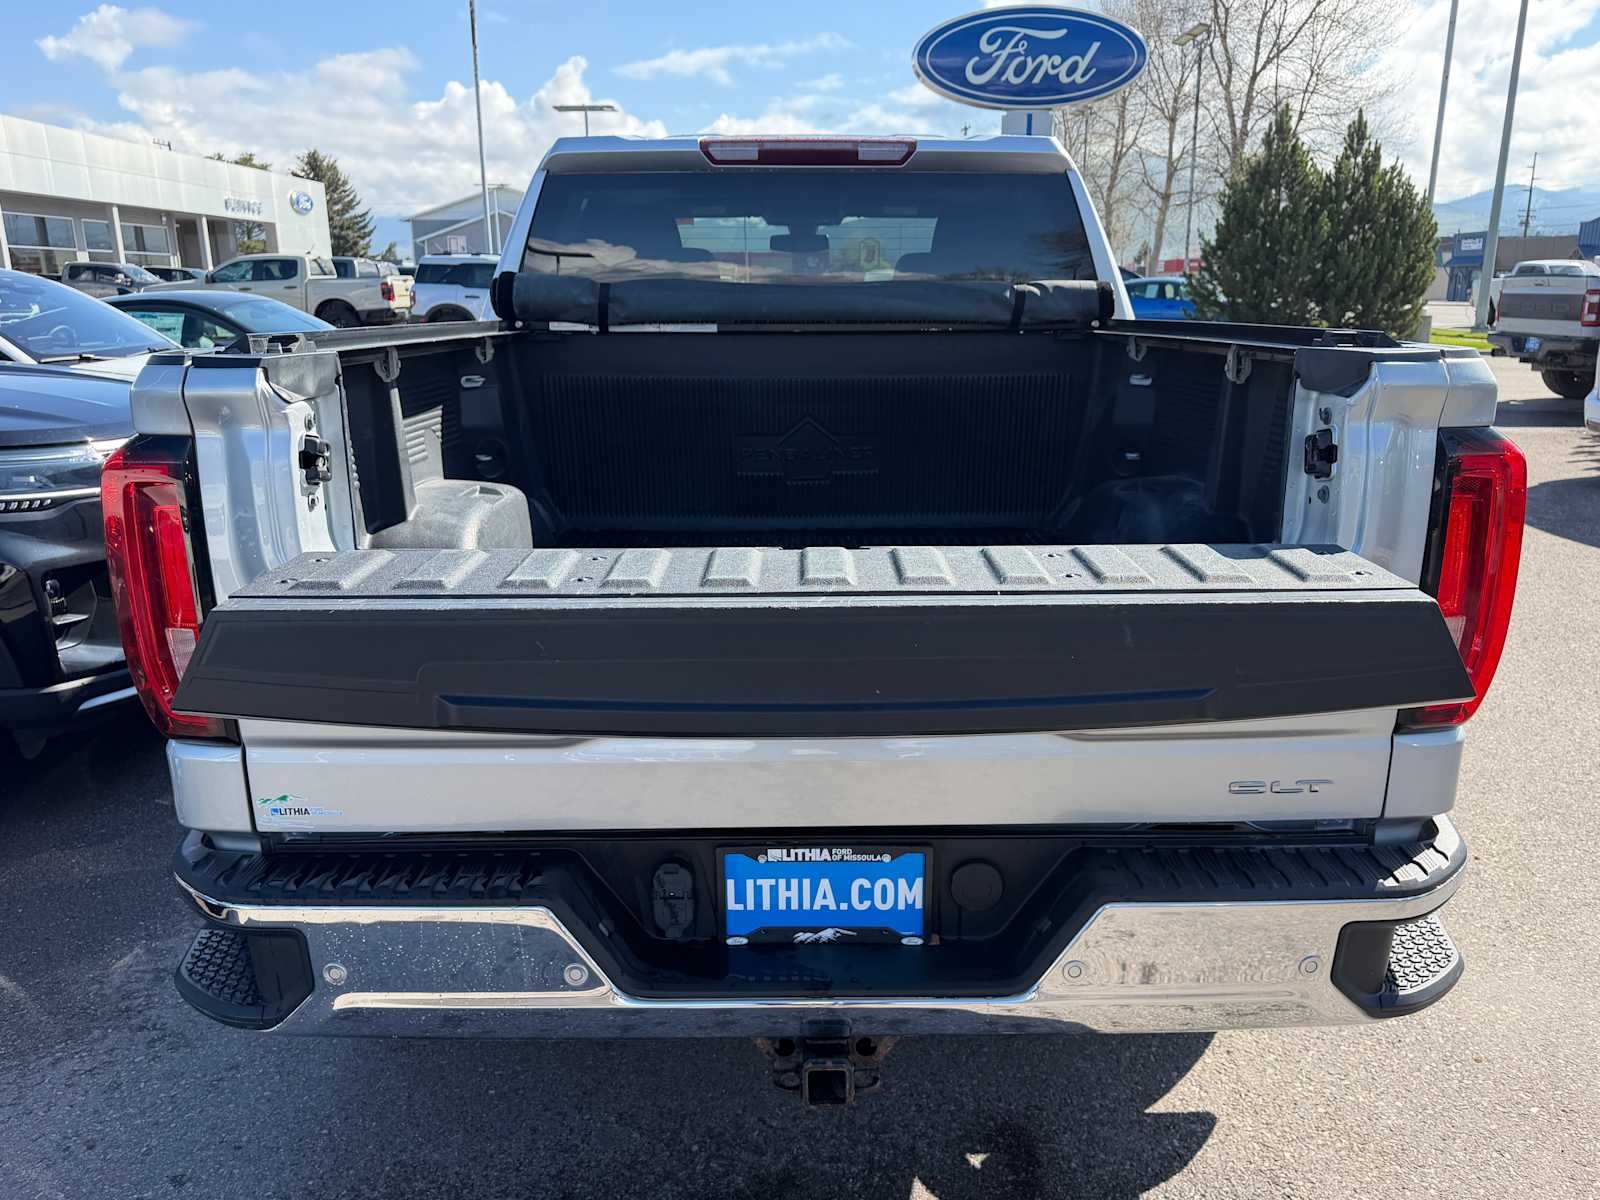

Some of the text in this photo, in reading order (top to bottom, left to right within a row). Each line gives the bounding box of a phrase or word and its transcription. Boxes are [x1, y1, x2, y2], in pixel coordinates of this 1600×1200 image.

[965, 26, 1101, 85] Ford
[1229, 779, 1334, 794] SLT
[280, 807, 310, 816] LITHIA
[782, 848, 831, 861] LITHIA
[727, 878, 923, 911] LITHIA.COM
